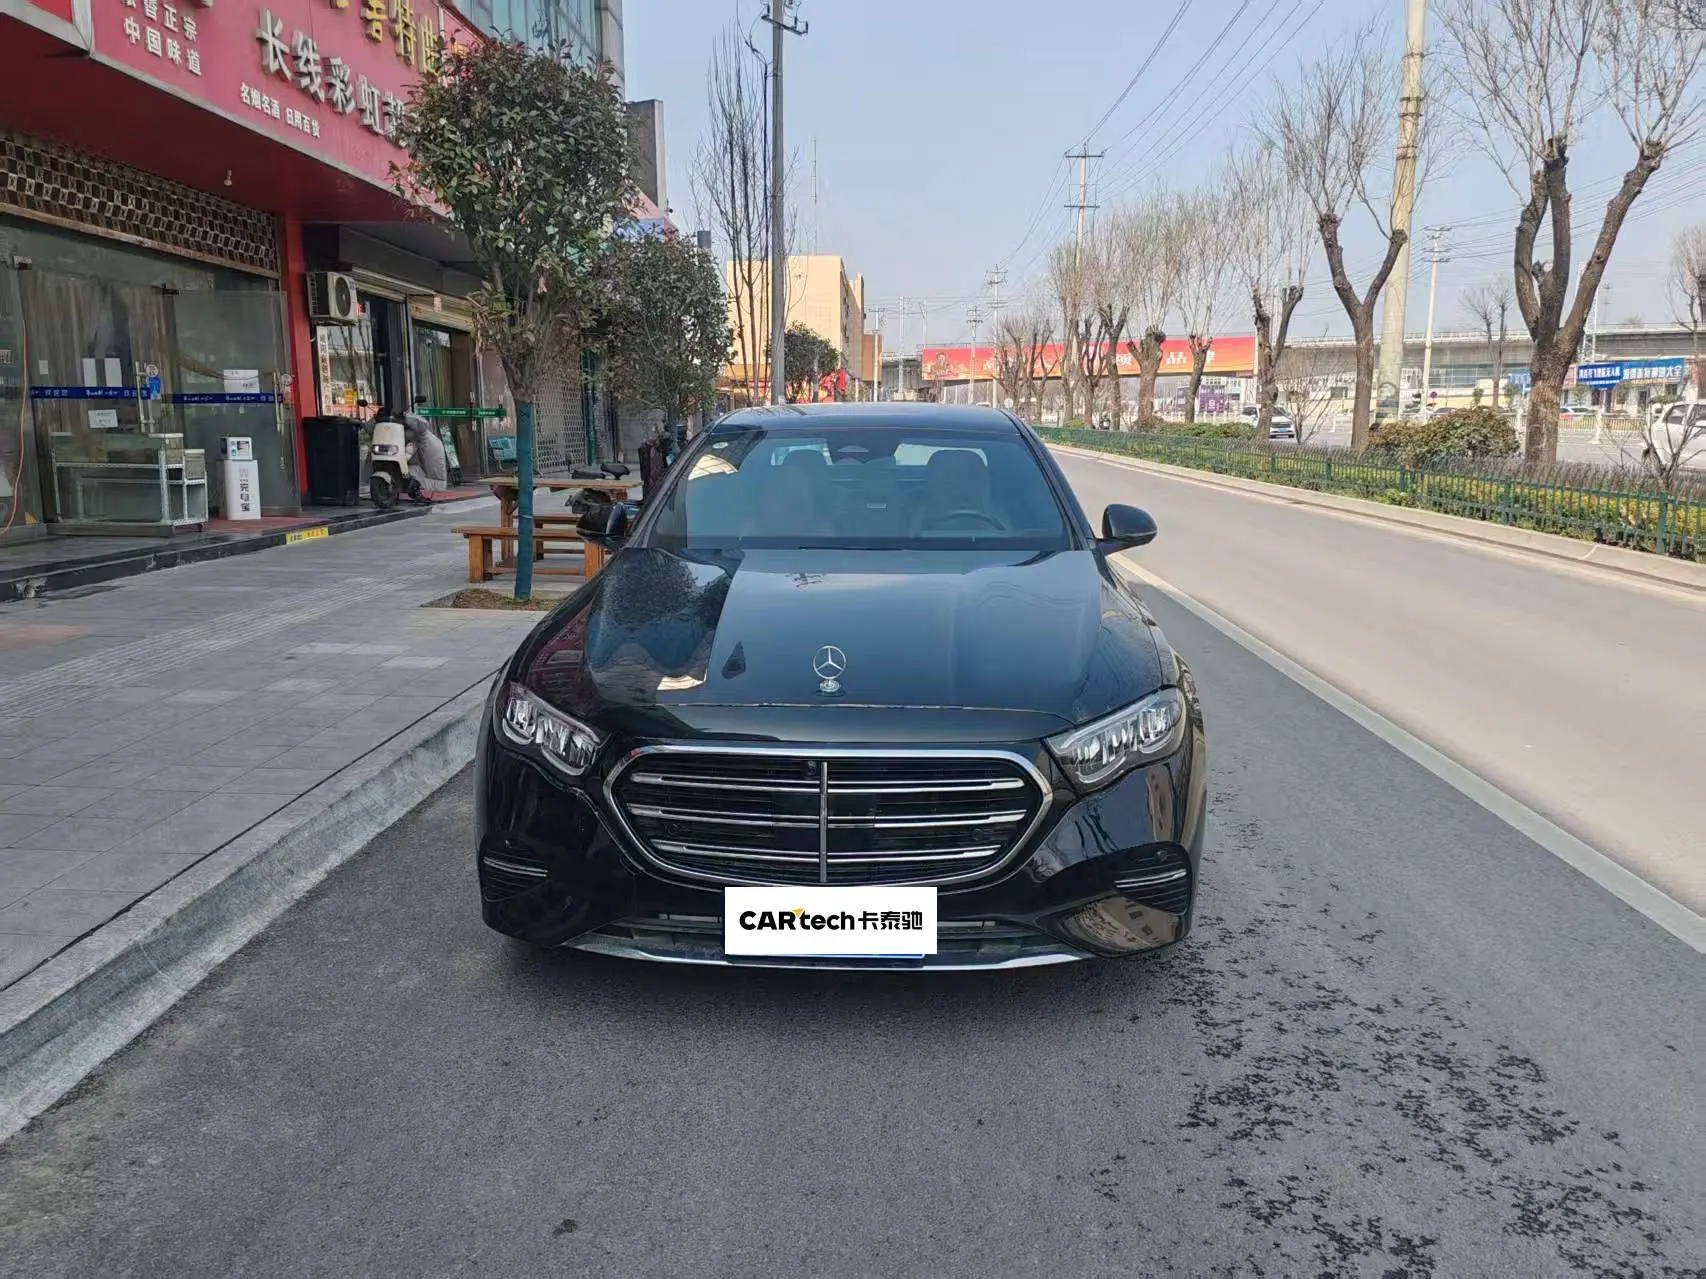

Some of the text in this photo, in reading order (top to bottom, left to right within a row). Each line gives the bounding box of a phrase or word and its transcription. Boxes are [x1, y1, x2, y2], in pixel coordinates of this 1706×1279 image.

[120, 0, 198, 42] 香正宗
[123, 15, 202, 76] 中国味道
[240, 83, 320, 138] 名烟名酒 日用百货
